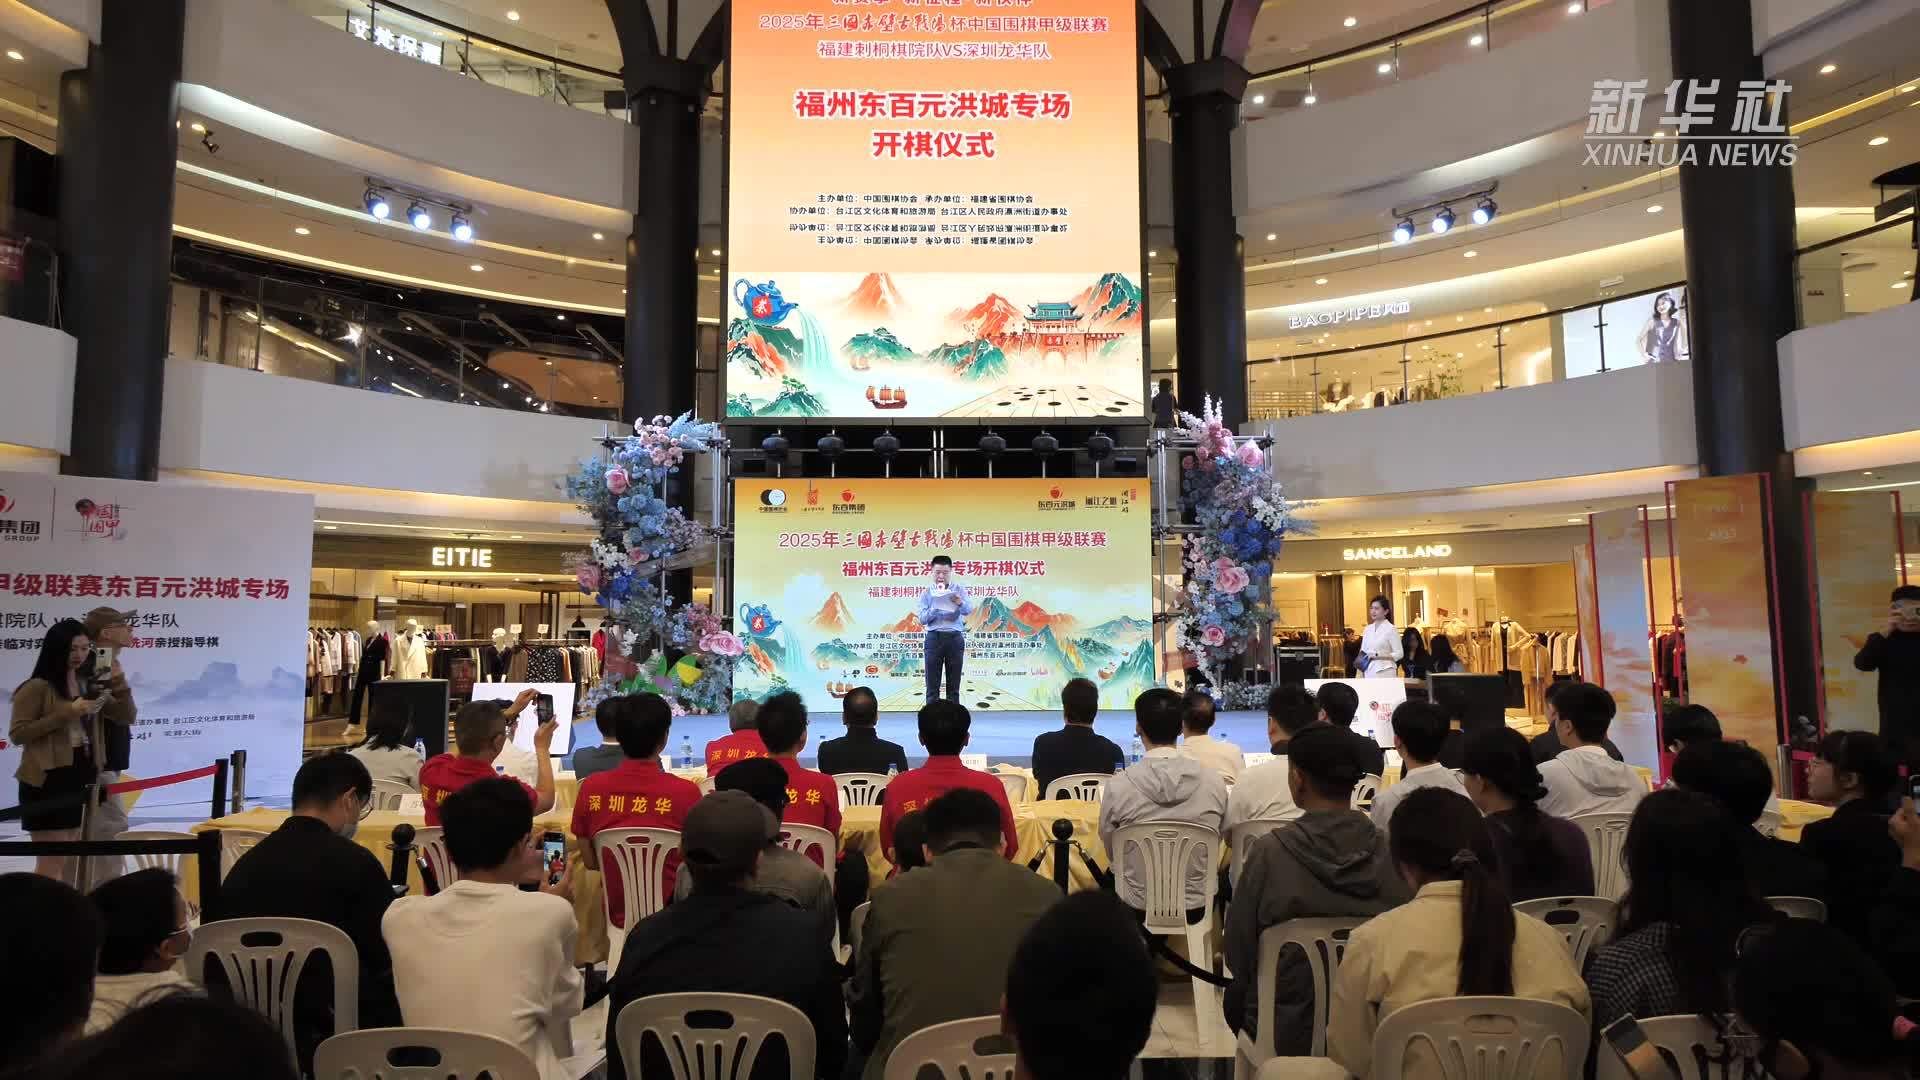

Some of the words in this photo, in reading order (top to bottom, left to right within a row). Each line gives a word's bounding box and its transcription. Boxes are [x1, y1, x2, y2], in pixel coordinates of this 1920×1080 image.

[818, 42, 1051, 59] 福建刺桐棋院队VS深圳龙华队
[796, 92, 1071, 118] 福州东百元洪城专场
[873, 131, 995, 157] 开棋仪式
[432, 547, 492, 568] EITIE
[842, 561, 1045, 577] 福州东百元洪专场开棋仪式
[0, 612, 48, 629] 院队
[127, 636, 220, 650] 洗河亲授指导棋
[866, 632, 925, 640] 主办单位：中国围棋
[588, 794, 673, 816] 深圳龙华
[785, 787, 821, 806] 龙华
